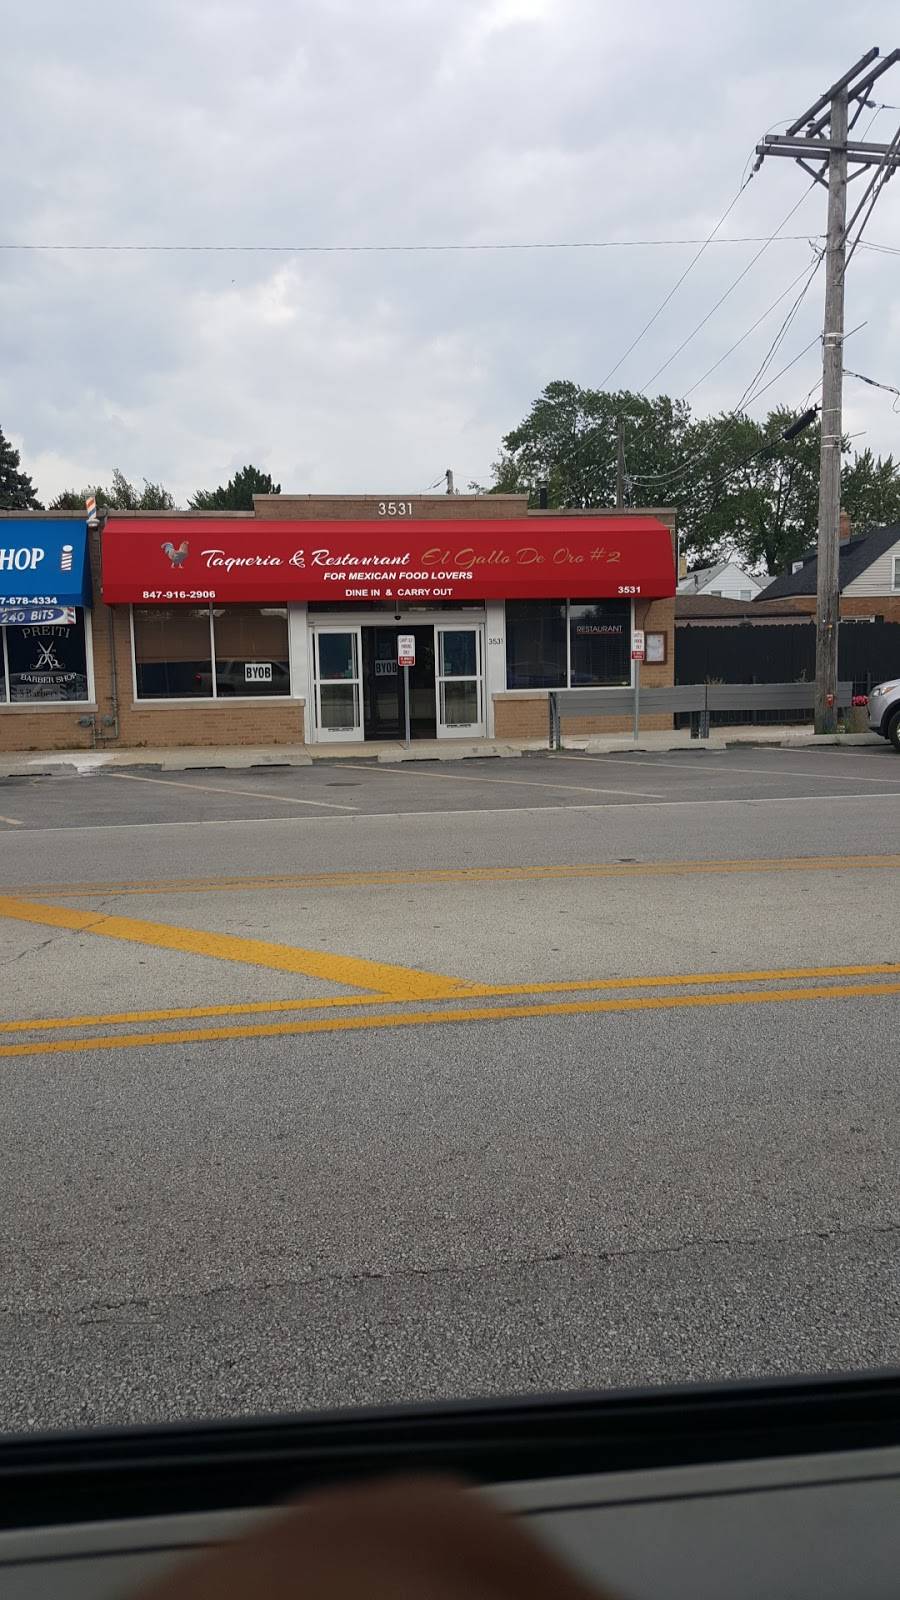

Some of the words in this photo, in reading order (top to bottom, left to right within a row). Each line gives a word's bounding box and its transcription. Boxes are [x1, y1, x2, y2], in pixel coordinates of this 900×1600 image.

[378, 502, 412, 515] 3531
[200, 549, 283, 572] Taqueria
[288, 550, 306, 569] &
[311, 549, 410, 566] Restaurant
[421, 548, 450, 566] El
[454, 548, 511, 569] Gallo
[516, 547, 546, 564] De
[552, 548, 585, 564] Oro
[399, 572, 429, 580] FOOD
[431, 572, 473, 580] LOVERS
[142, 591, 216, 599] 847-916-2906
[345, 589, 368, 597] DINE
[385, 588, 393, 596] &
[397, 588, 430, 596] CARRY
[433, 588, 453, 596] OUT
[618, 586, 641, 594] 3531
[1, 612, 26, 623] 240
[576, 625, 623, 633] RESTAURANT
[246, 666, 271, 679] BYOB
[376, 662, 397, 674] BYOB
[20, 674, 55, 684] BARBER
[57, 672, 77, 684] SHOP
